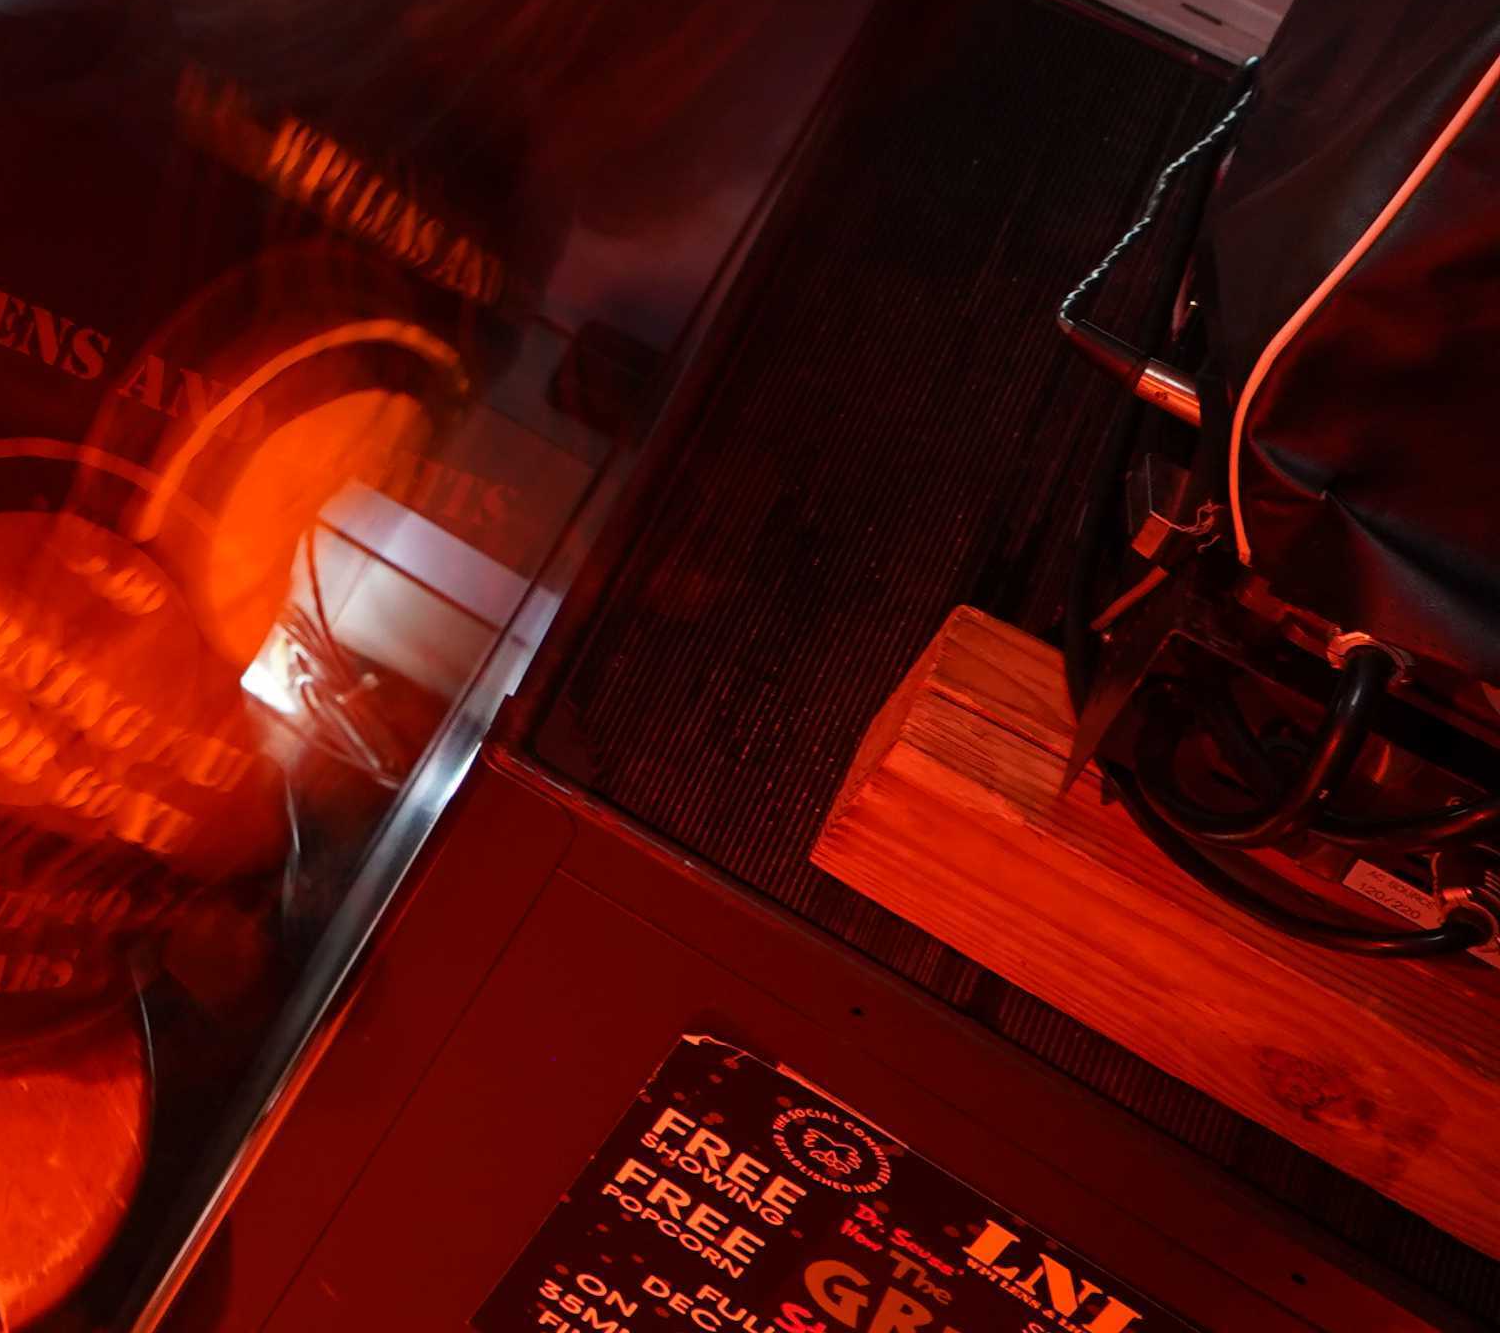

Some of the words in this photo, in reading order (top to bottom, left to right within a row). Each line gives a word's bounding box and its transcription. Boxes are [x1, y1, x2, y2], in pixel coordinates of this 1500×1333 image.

[116, 354, 267, 444] AND
[1357, 883, 1422, 920] 120/220
[651, 1106, 808, 1215] FREE
[772, 1113, 791, 1132] THE
[787, 1107, 840, 1125] SOCIAL
[842, 1121, 892, 1184] COMMITTEE
[772, 1133, 852, 1193] ESTABLISHED
[639, 1132, 785, 1227] SHOWING
[600, 1182, 745, 1279] POPCORN
[613, 1157, 766, 1265] FREE
[839, 1219, 884, 1253] How
[853, 1202, 887, 1234] Dr.
[537, 1277, 632, 1333] 35M
[575, 1273, 639, 1319] ON
[641, 1274, 723, 1333] DEC
[888, 1248, 953, 1306] The
[965, 1256, 1001, 1282] WPI
[999, 1278, 1043, 1310] LENS
